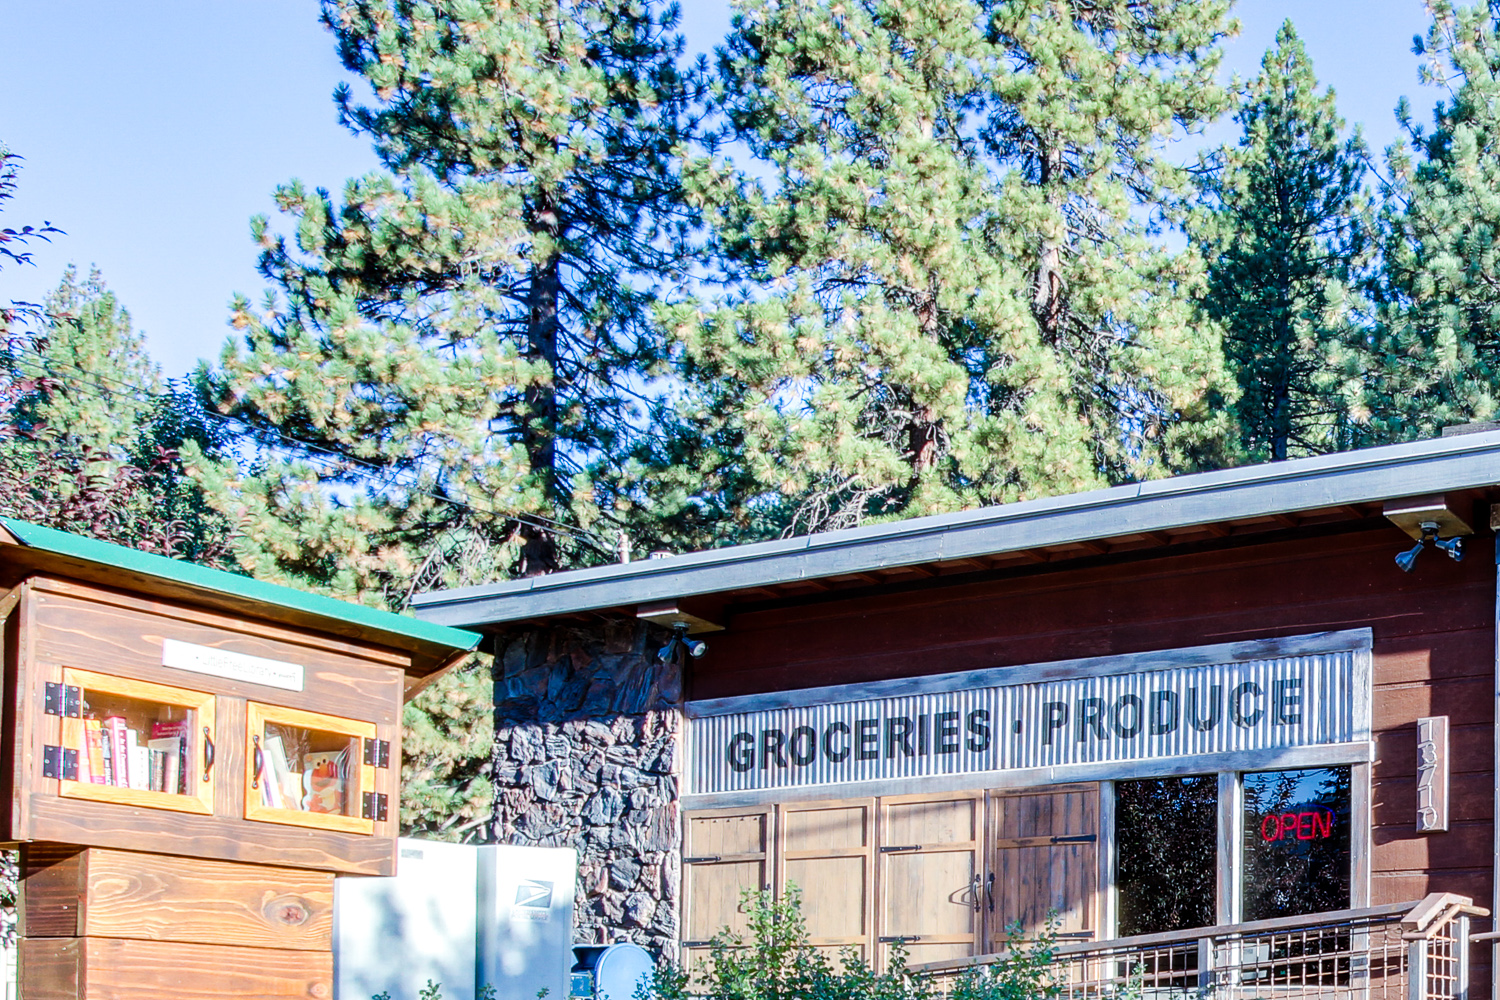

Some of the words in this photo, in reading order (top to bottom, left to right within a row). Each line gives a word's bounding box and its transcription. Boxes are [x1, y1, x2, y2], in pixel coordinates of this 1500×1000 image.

[727, 709, 991, 773] GROCERIES
[1041, 678, 1302, 746] PRODUCE
[1419, 719, 1438, 829] 13710
[1261, 811, 1332, 842] OPEN
